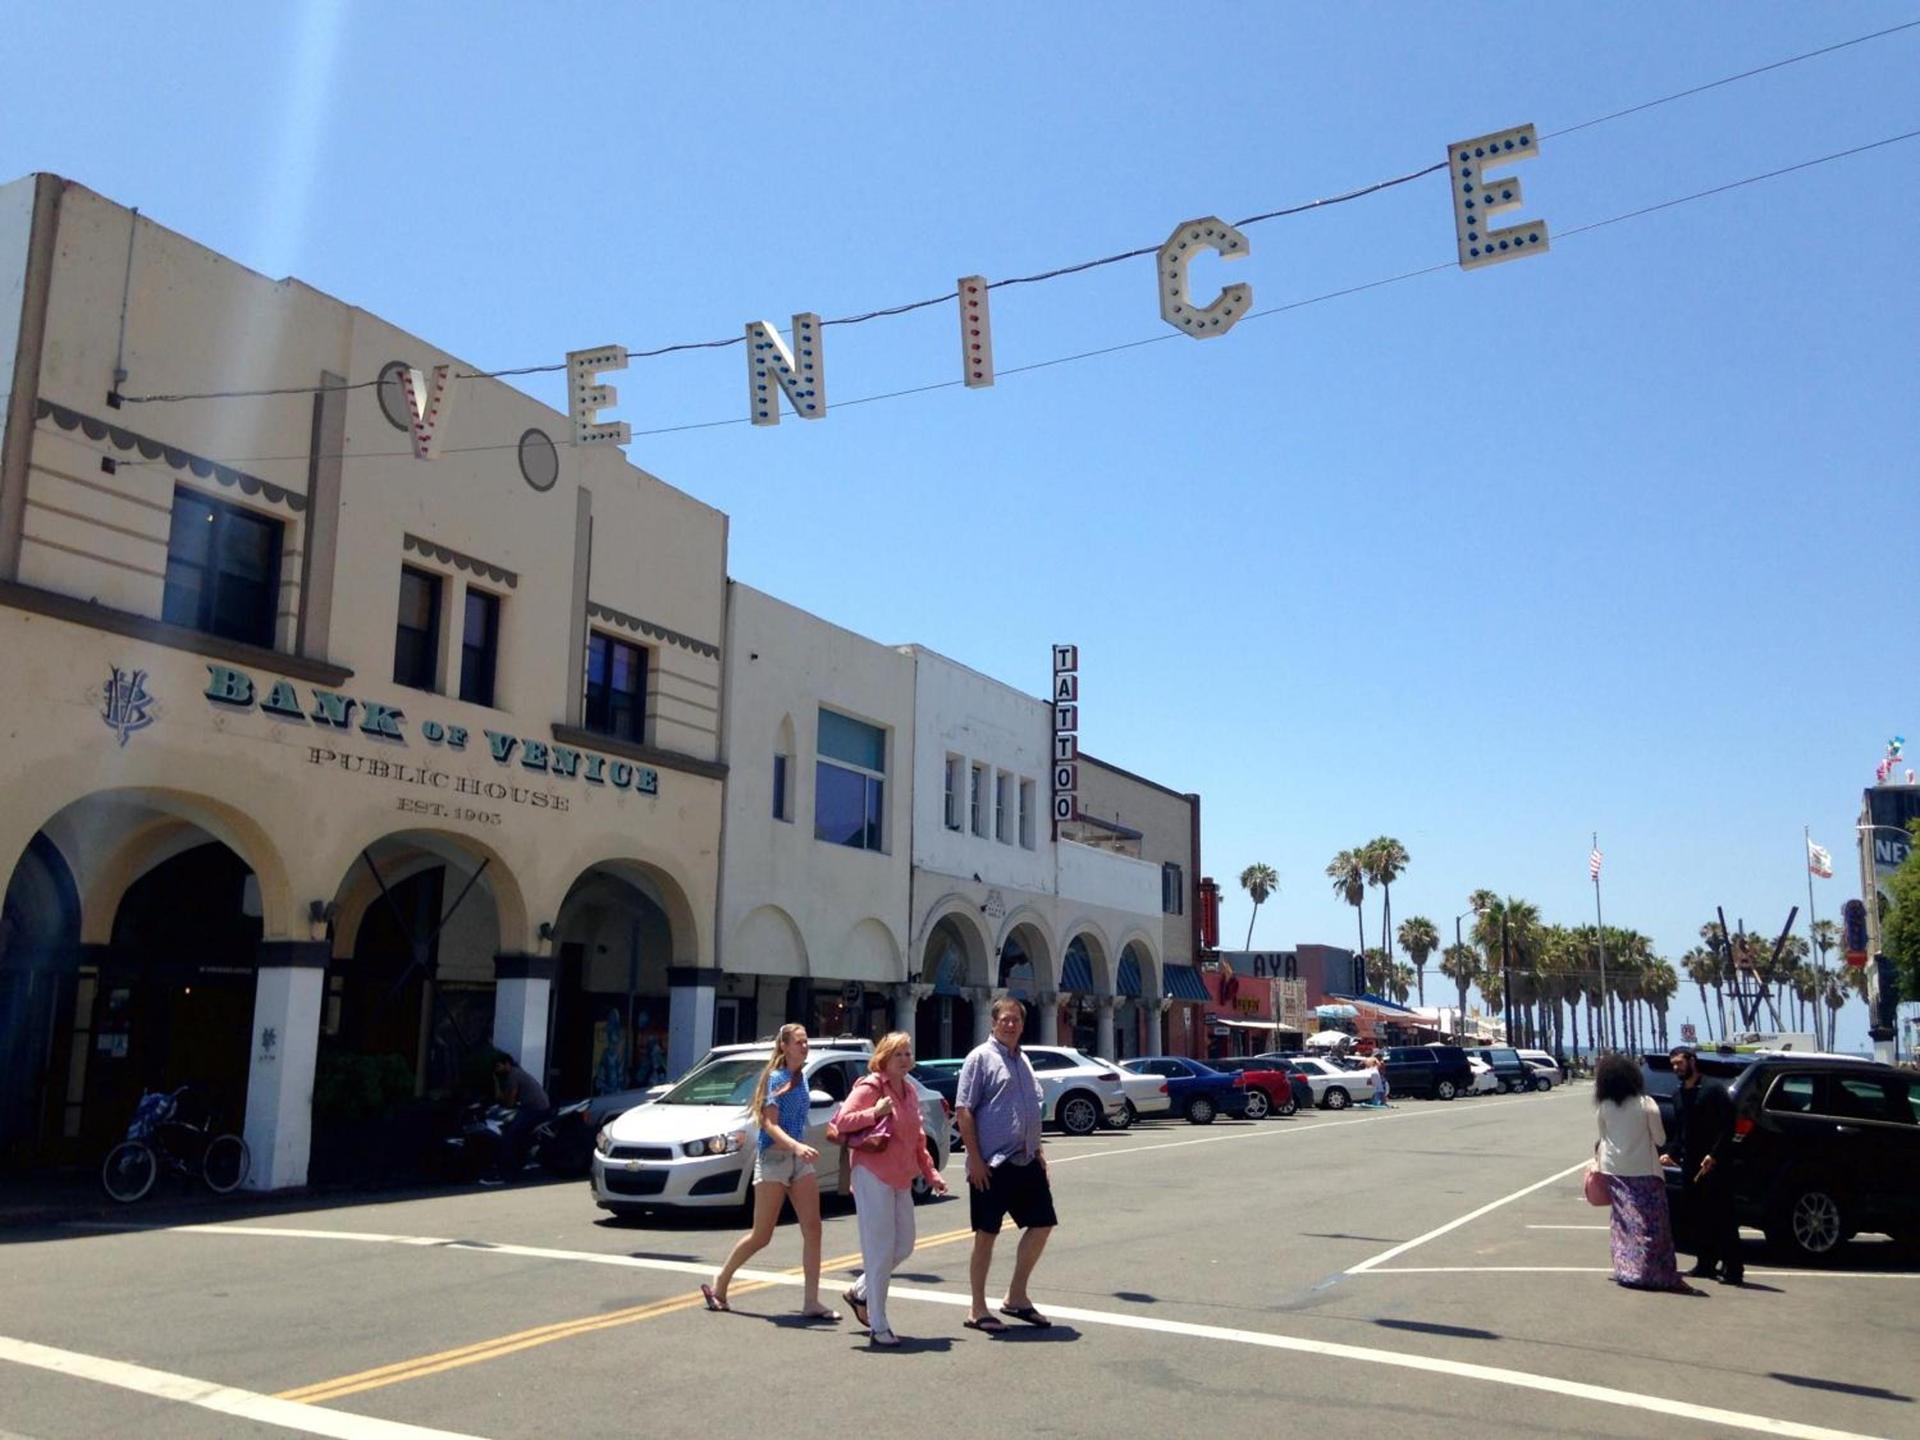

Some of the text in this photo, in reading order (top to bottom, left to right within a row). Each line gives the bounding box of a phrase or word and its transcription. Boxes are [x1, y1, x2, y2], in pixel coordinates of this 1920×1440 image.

[399, 122, 1550, 461] VENICE
[204, 664, 408, 746] BANK
[422, 720, 469, 749] OF
[484, 728, 661, 798] VENICE
[306, 746, 571, 812] PUBLIC HOUSE
[1057, 649, 1071, 818] TATTOO
[396, 797, 450, 818] EST.
[1875, 839, 1911, 863] NE
